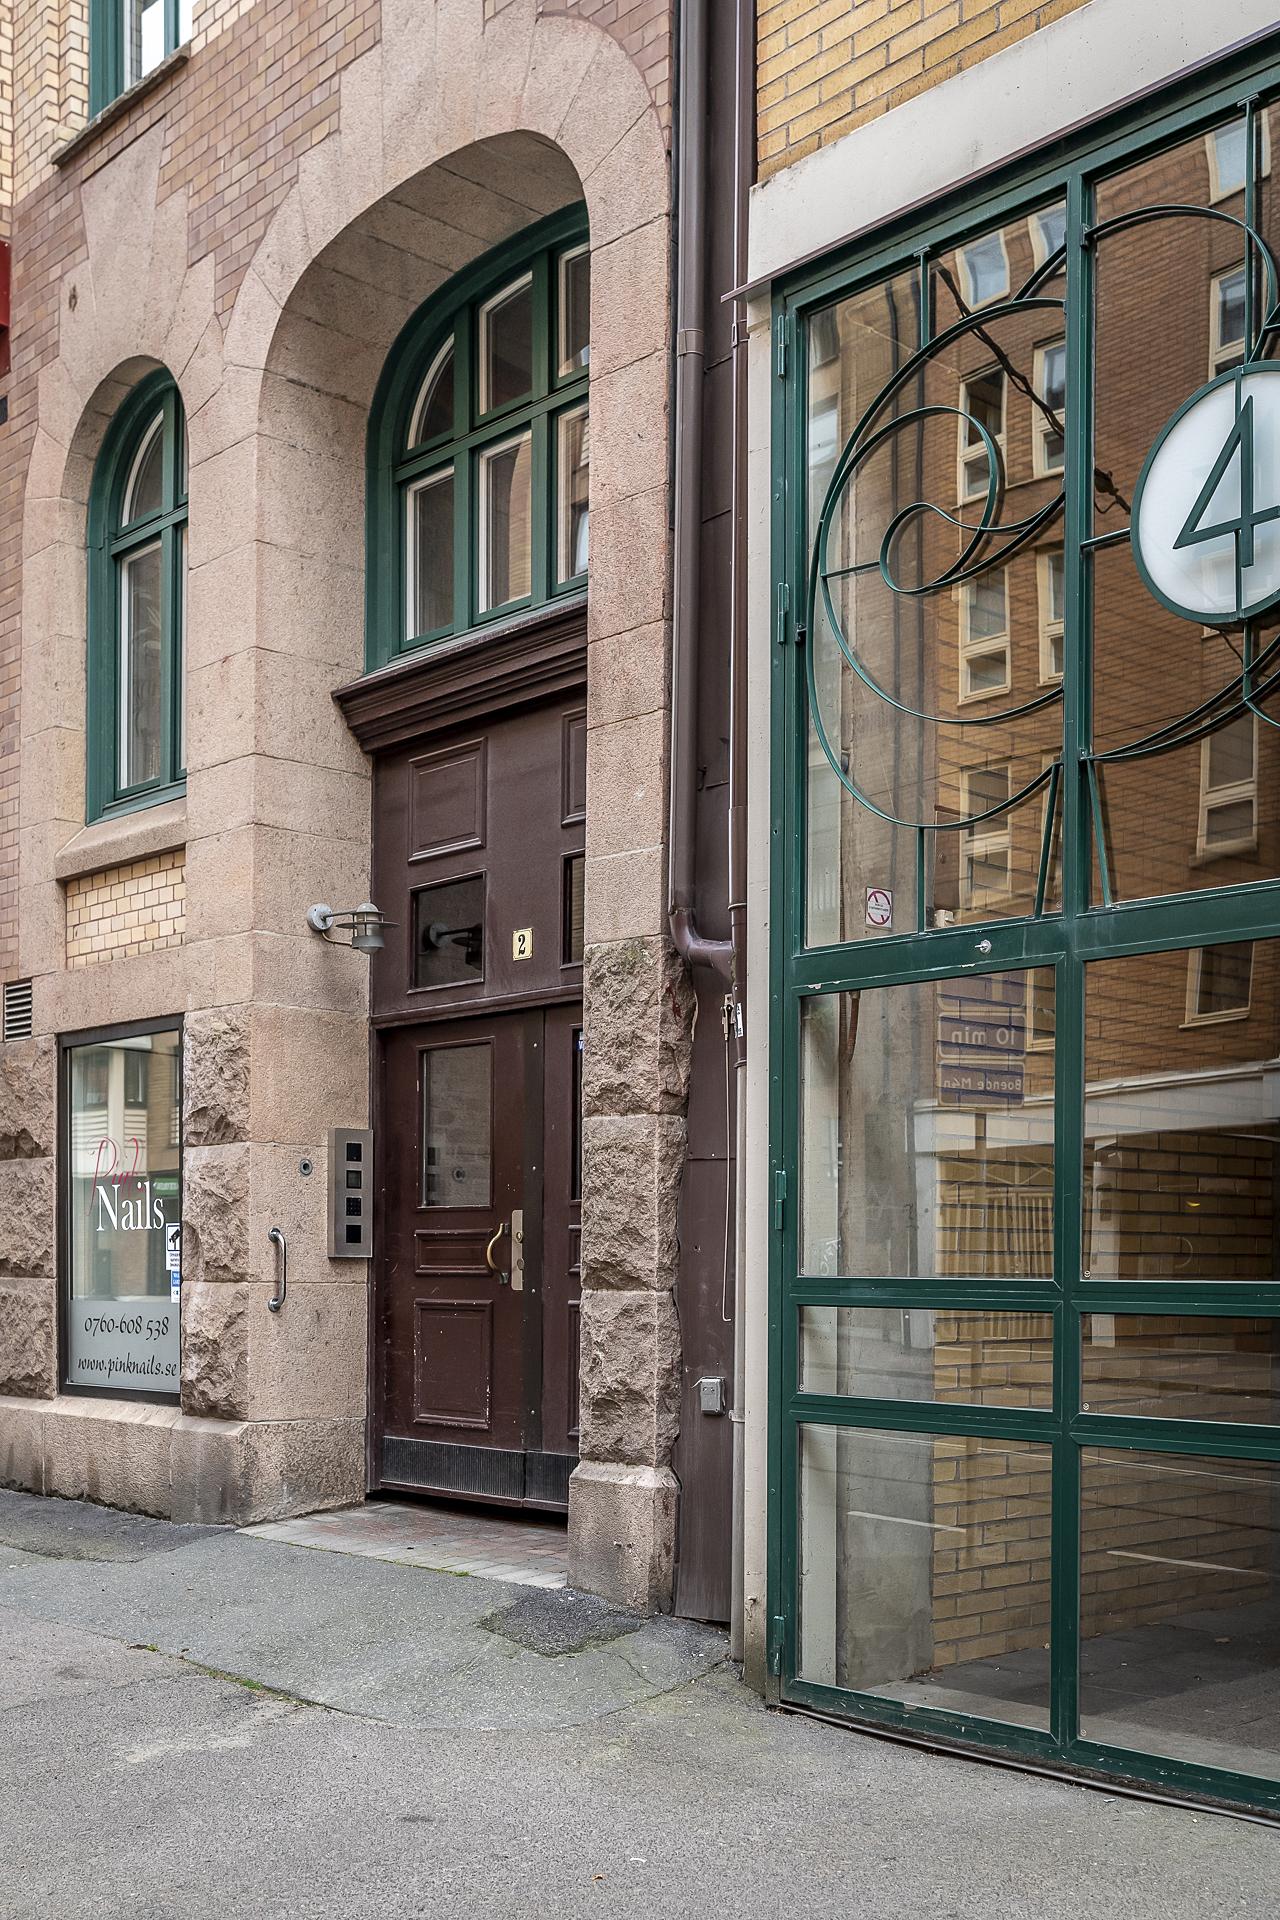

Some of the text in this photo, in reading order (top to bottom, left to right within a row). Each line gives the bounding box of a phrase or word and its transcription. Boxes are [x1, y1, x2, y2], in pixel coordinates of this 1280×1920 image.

[1173, 394, 1280, 568] 4
[518, 934, 526, 955] 2
[96, 1180, 165, 1232] Nails
[84, 1312, 169, 1341] 0760-608 538
[77, 1352, 177, 1379] www.pinknails.se
